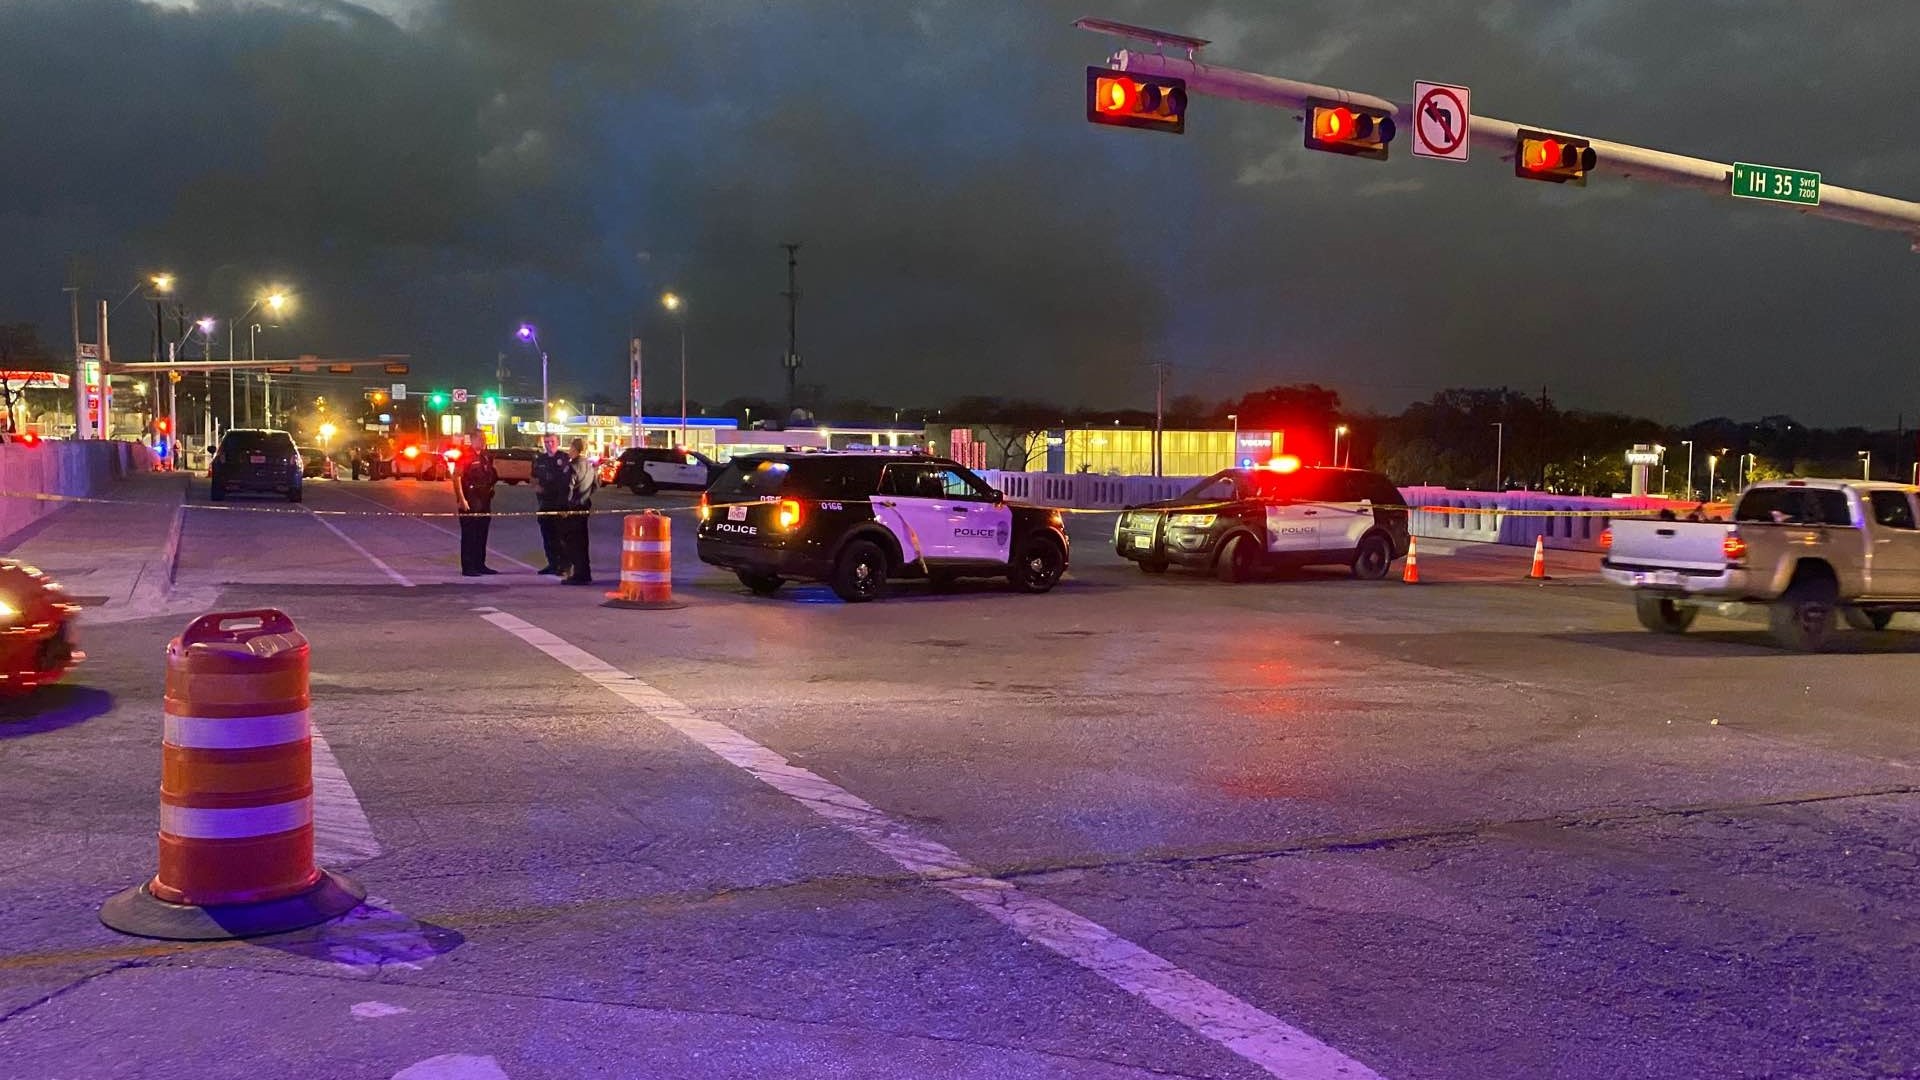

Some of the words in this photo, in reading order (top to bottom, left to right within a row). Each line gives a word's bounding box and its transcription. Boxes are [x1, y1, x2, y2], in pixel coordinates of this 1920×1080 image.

[1738, 169, 1743, 179] N
[1750, 171, 1766, 192] IH
[1774, 174, 1792, 196] 35
[1799, 177, 1815, 188] Svrd
[1799, 188, 1815, 198] 7200
[821, 502, 843, 511] 0166
[716, 523, 758, 535] POLICE
[954, 528, 994, 537] POLICE
[1281, 526, 1316, 534] POLICE
